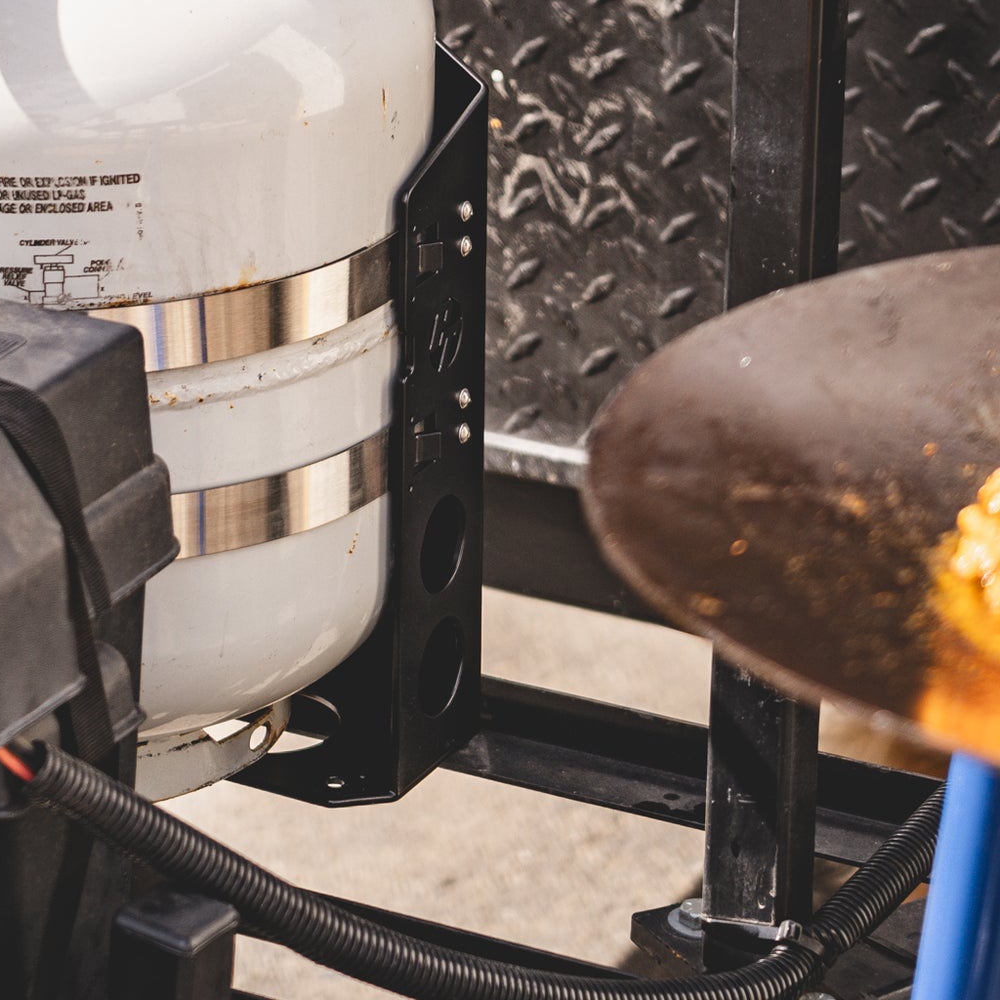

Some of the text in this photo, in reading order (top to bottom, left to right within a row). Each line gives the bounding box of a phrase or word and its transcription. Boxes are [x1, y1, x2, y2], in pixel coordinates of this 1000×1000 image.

[20, 176, 34, 188] OR
[89, 175, 98, 186] IF
[100, 173, 141, 186] IGNITED
[12, 190, 50, 201] UNUSED
[52, 189, 86, 200] LP-GAS
[20, 203, 34, 214] OR
[35, 202, 86, 214] ENCLOSED
[87, 201, 113, 213] AREA
